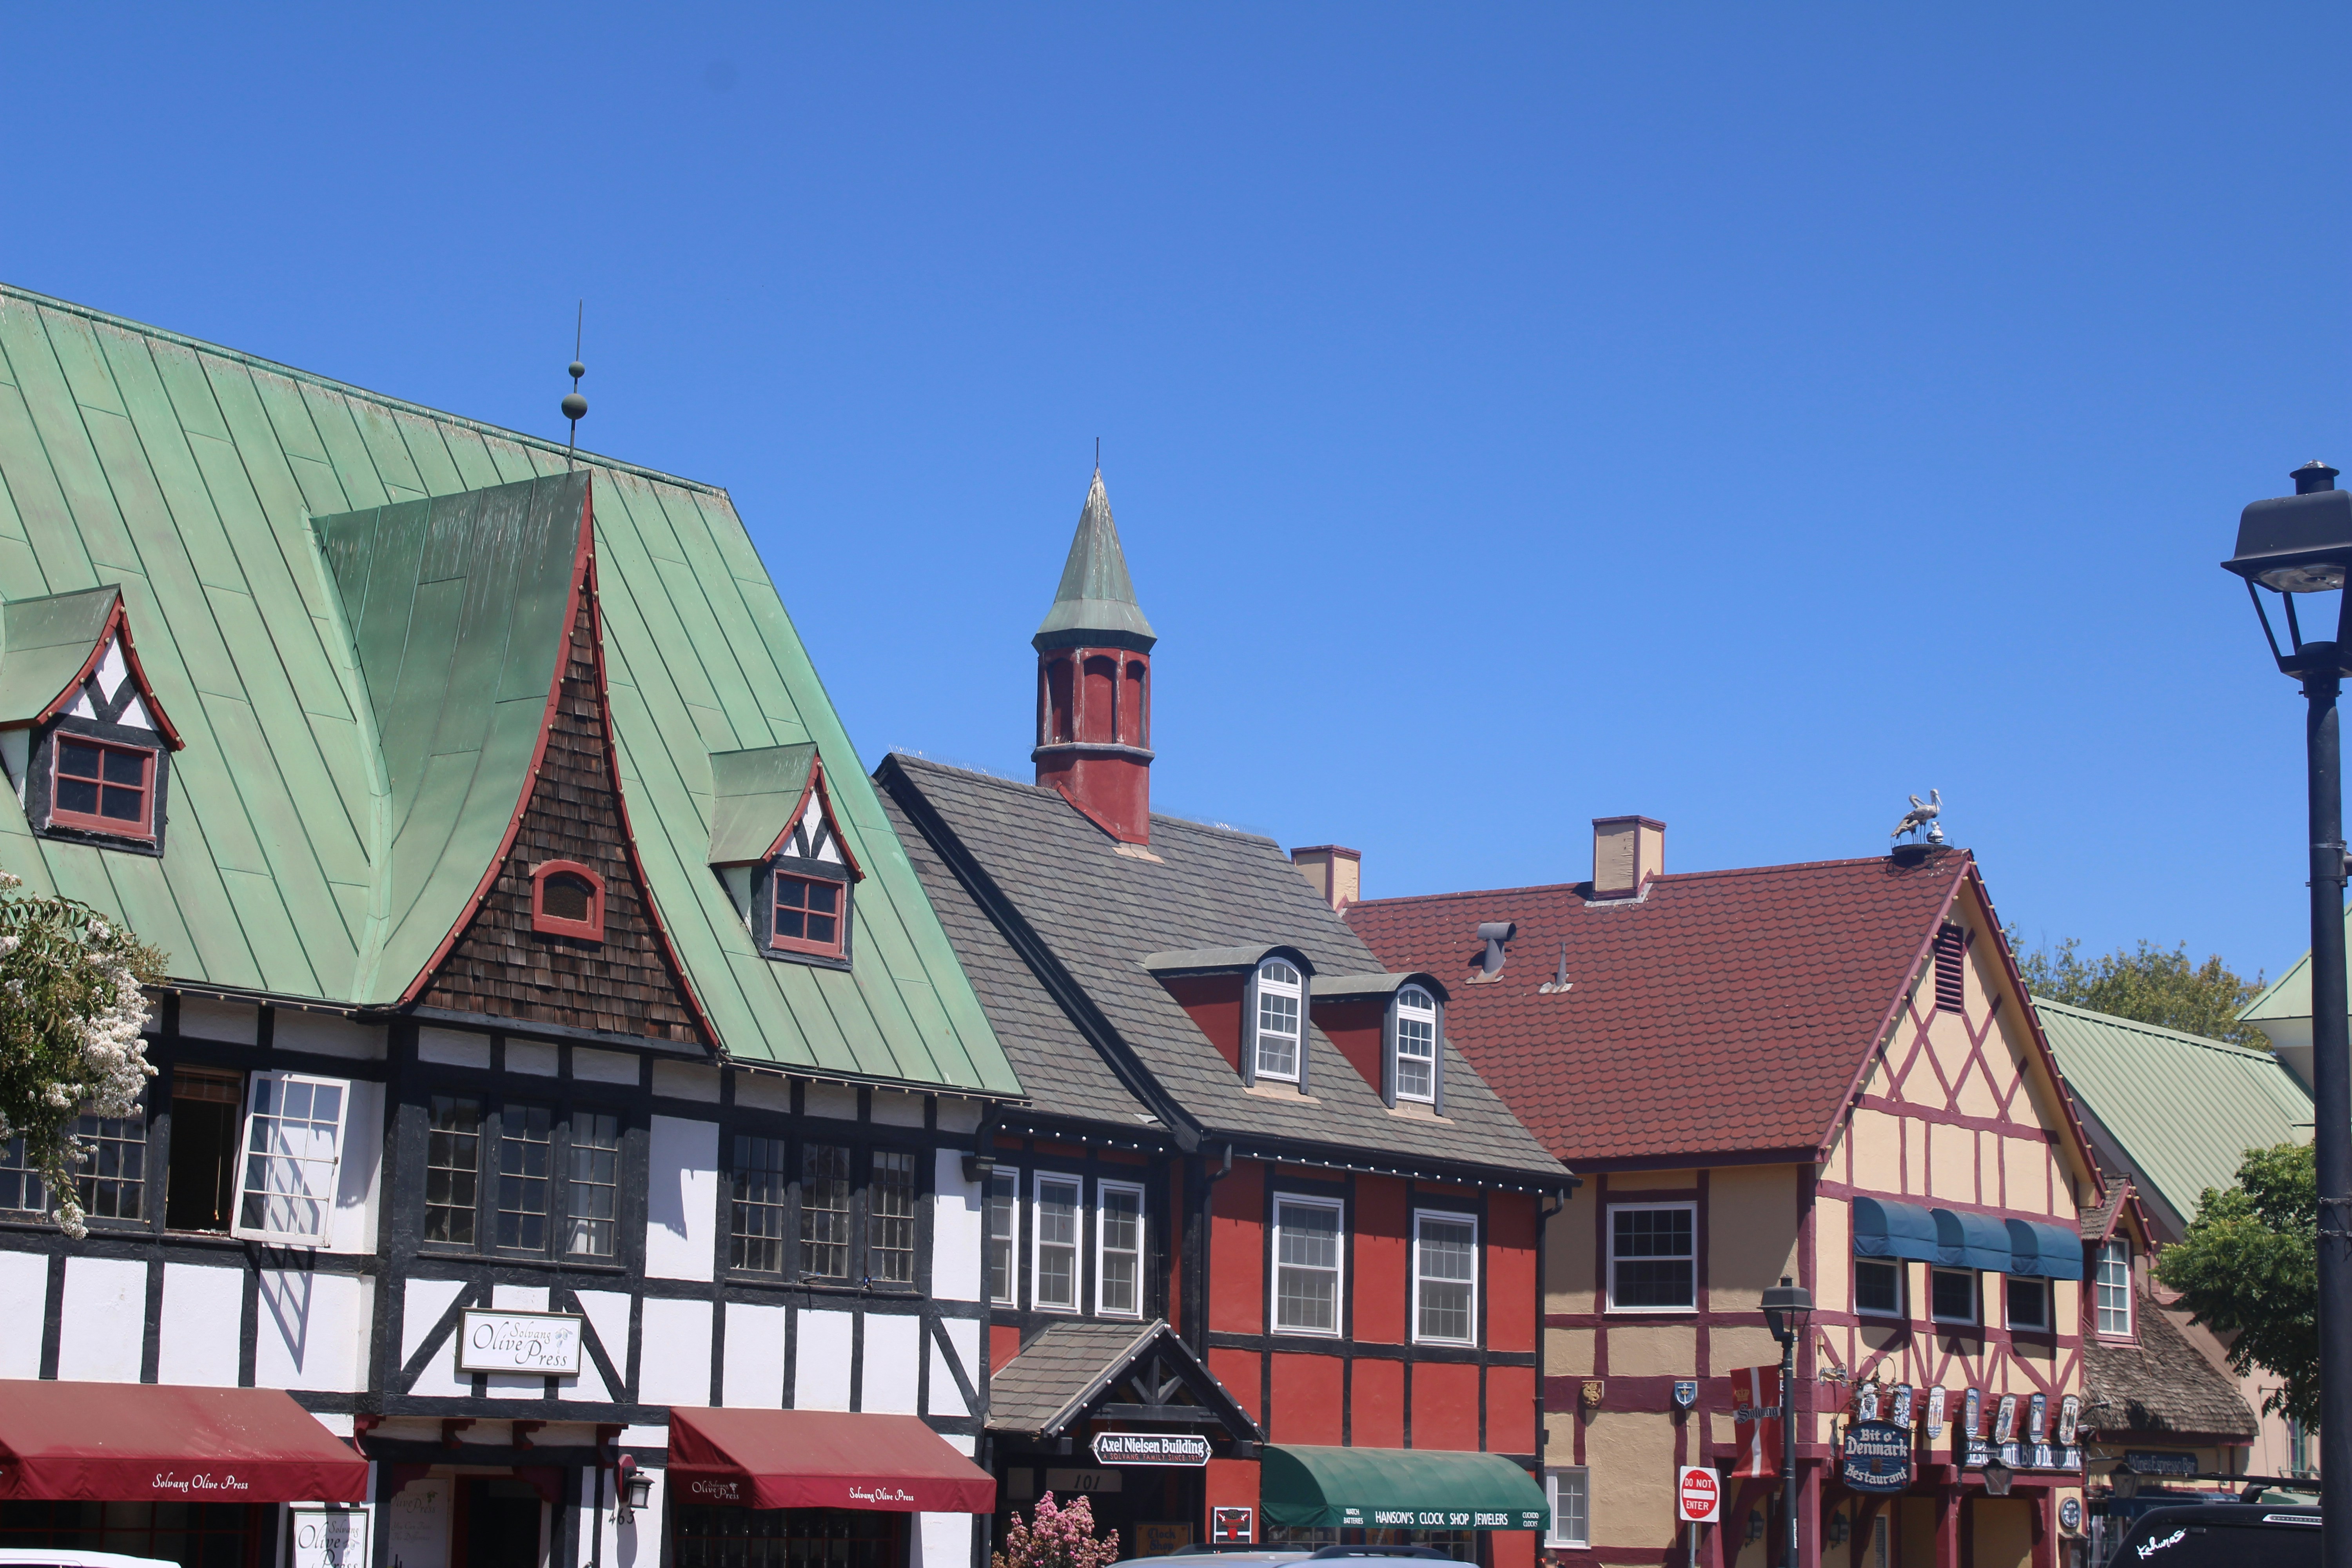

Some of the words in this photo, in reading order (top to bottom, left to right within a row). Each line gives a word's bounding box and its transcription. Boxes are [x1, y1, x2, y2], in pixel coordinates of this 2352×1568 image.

[473, 1321, 523, 1349] Olive
[510, 1321, 551, 1344] Solvang
[515, 1339, 567, 1367] Press
[1860, 1428, 1881, 1441] Bit
[1883, 1431, 1896, 1443] o'
[1101, 1437, 1122, 1453] Axel
[1125, 1437, 1160, 1454] Nielsen
[1161, 1438, 1204, 1458] Building
[1845, 1436, 1908, 1457] Denmark
[152, 1472, 189, 1493] Solvang
[192, 1473, 218, 1489] Olive
[221, 1475, 249, 1489] Press
[1074, 1474, 1100, 1490] 101
[1844, 1463, 1907, 1485] Restaurant
[692, 1480, 717, 1493] Olive
[708, 1480, 729, 1490] Solvang
[1685, 1478, 1693, 1487] DO
[1696, 1479, 1713, 1488] NOT
[714, 1488, 739, 1499] Press
[849, 1486, 875, 1503] Solvang
[875, 1487, 893, 1501] Olive
[895, 1489, 914, 1501] Press
[1686, 1500, 1709, 1511] ENTER
[608, 1508, 636, 1527] 463
[1375, 1510, 1414, 1524] HANSON'S
[1419, 1512, 1445, 1525] CLOCK
[1450, 1512, 1469, 1525] SHOP
[1473, 1511, 1508, 1527] JEWELERS
[298, 1521, 341, 1549] Olive
[329, 1519, 359, 1538] Solvang
[1148, 1528, 1176, 1539] Clock
[1150, 1539, 1174, 1551] Shop
